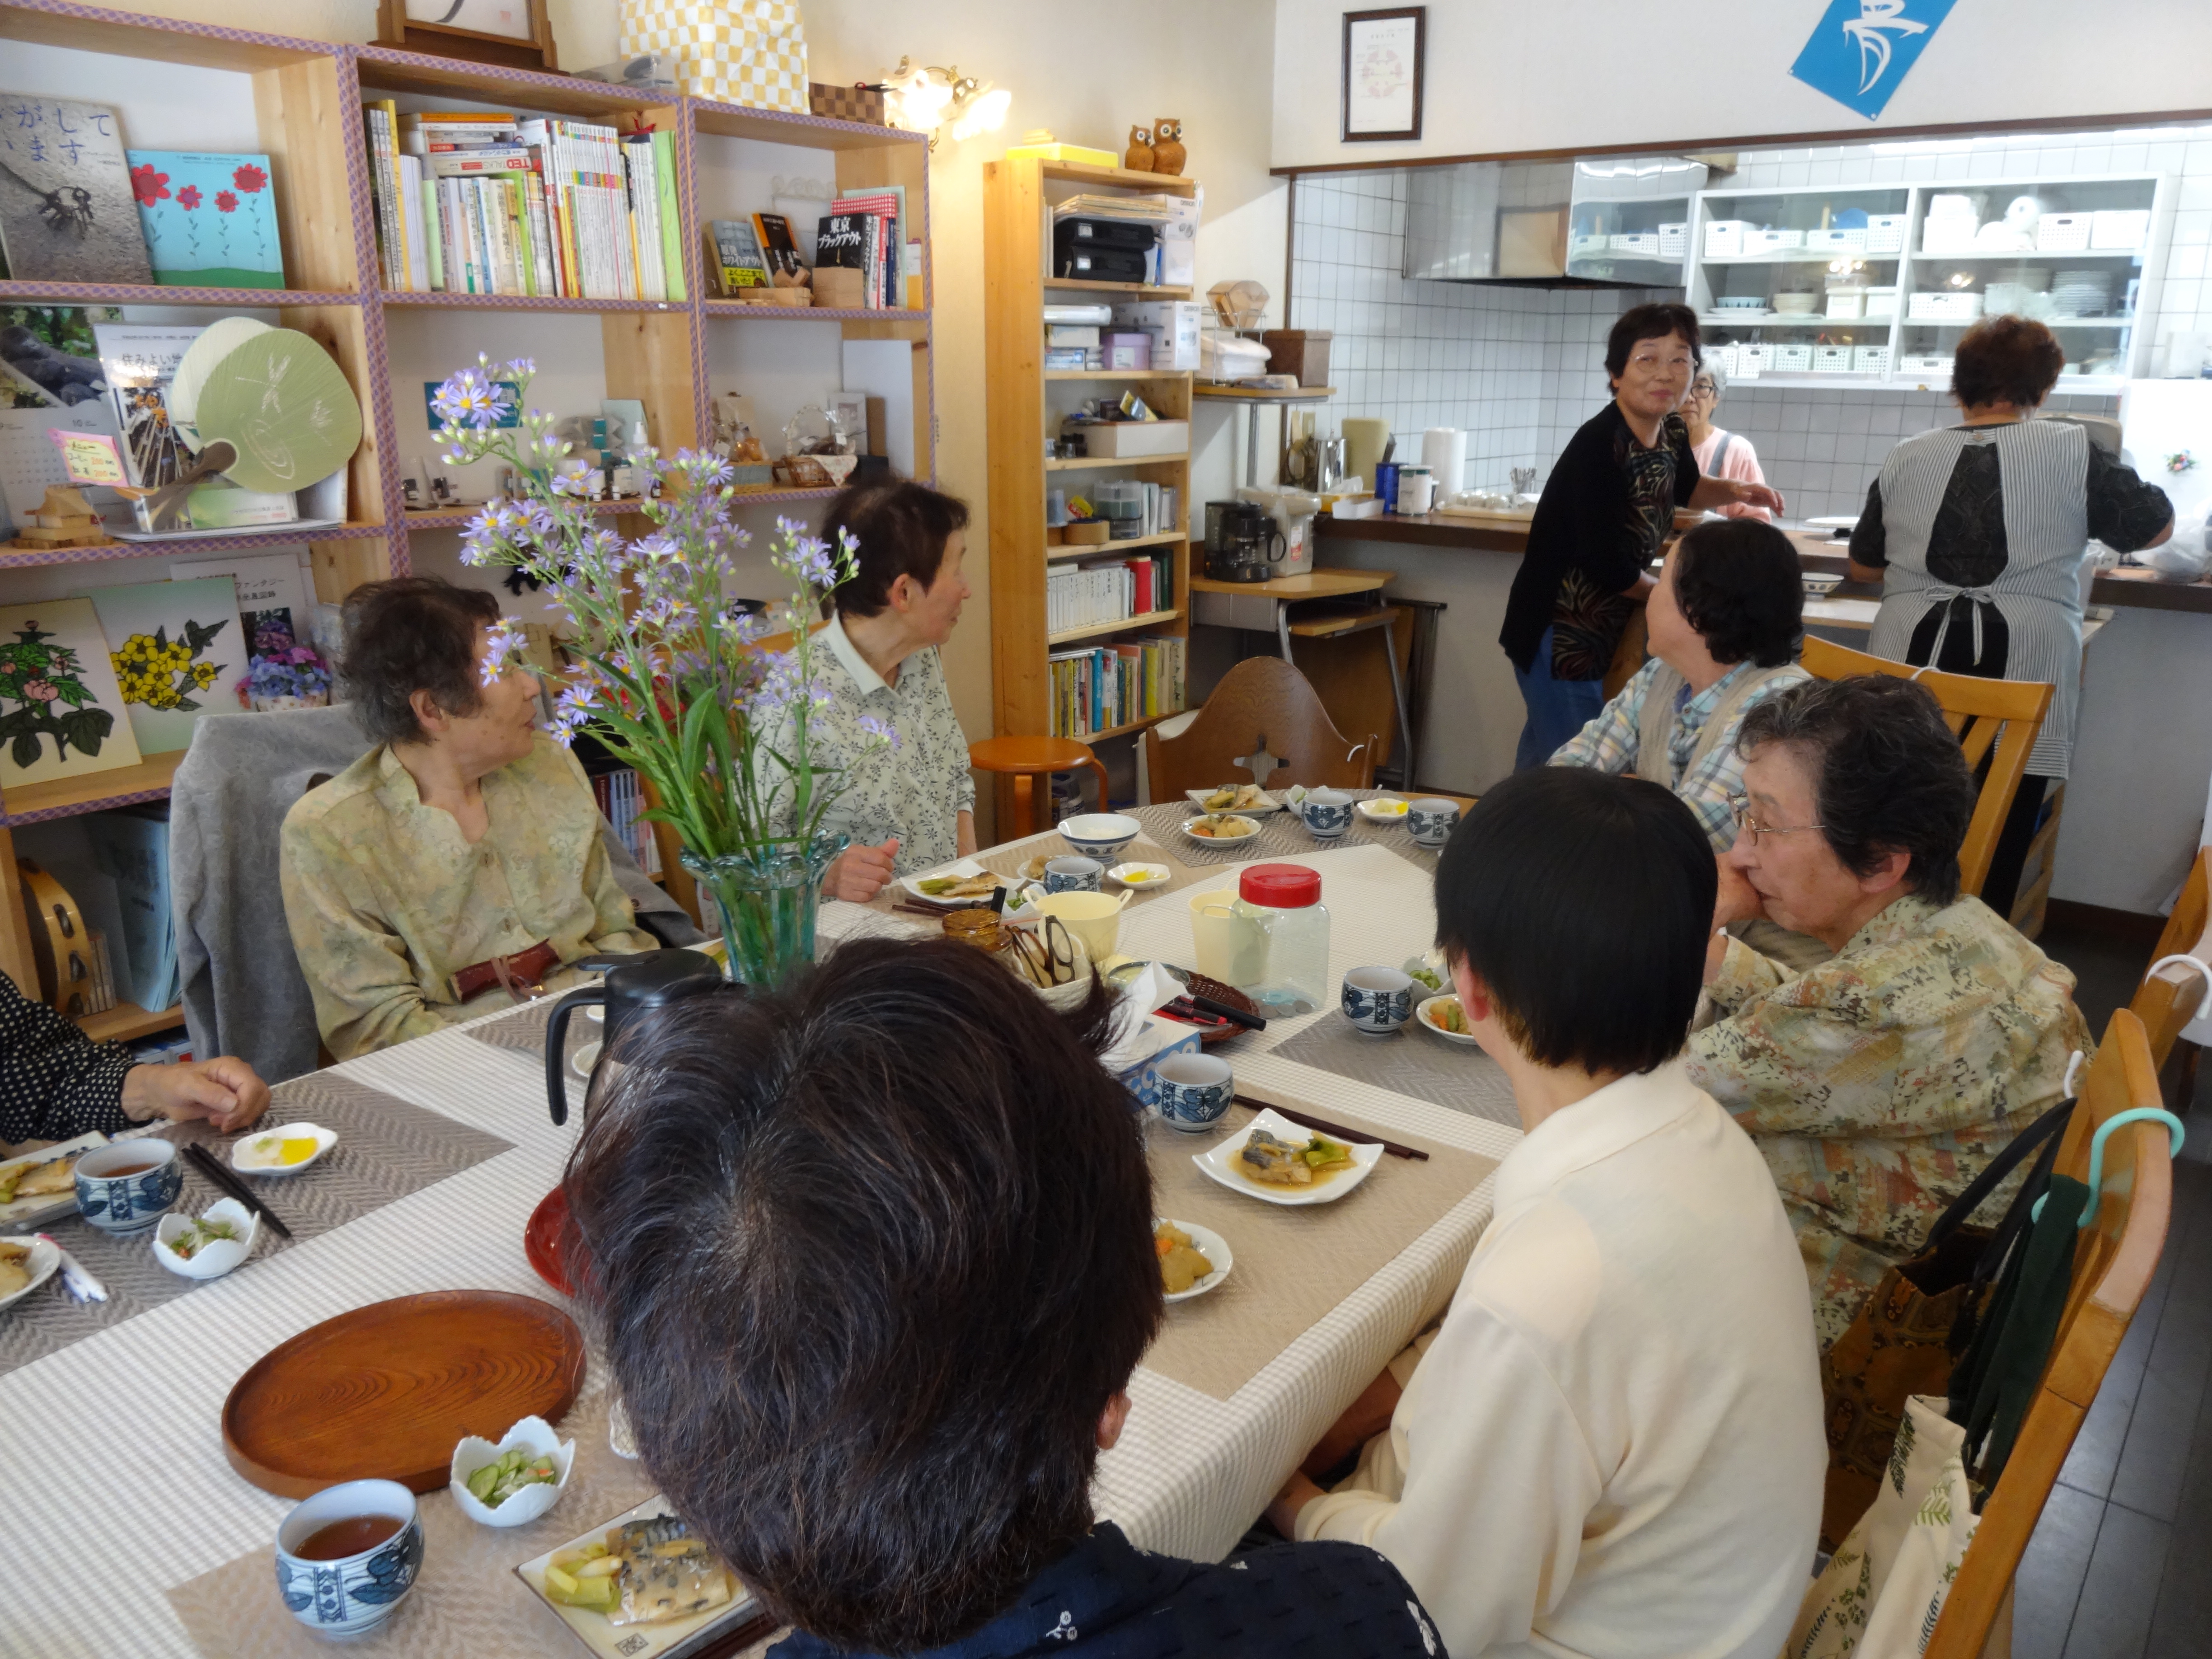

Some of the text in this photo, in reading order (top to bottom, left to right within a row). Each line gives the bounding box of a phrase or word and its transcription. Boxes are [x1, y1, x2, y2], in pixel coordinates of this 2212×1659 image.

[0, 103, 110, 136] がして
[483, 160, 506, 169] TALKS
[506, 158, 530, 169] TED
[830, 216, 851, 233] 東京
[818, 231, 862, 249] ブラックアウト
